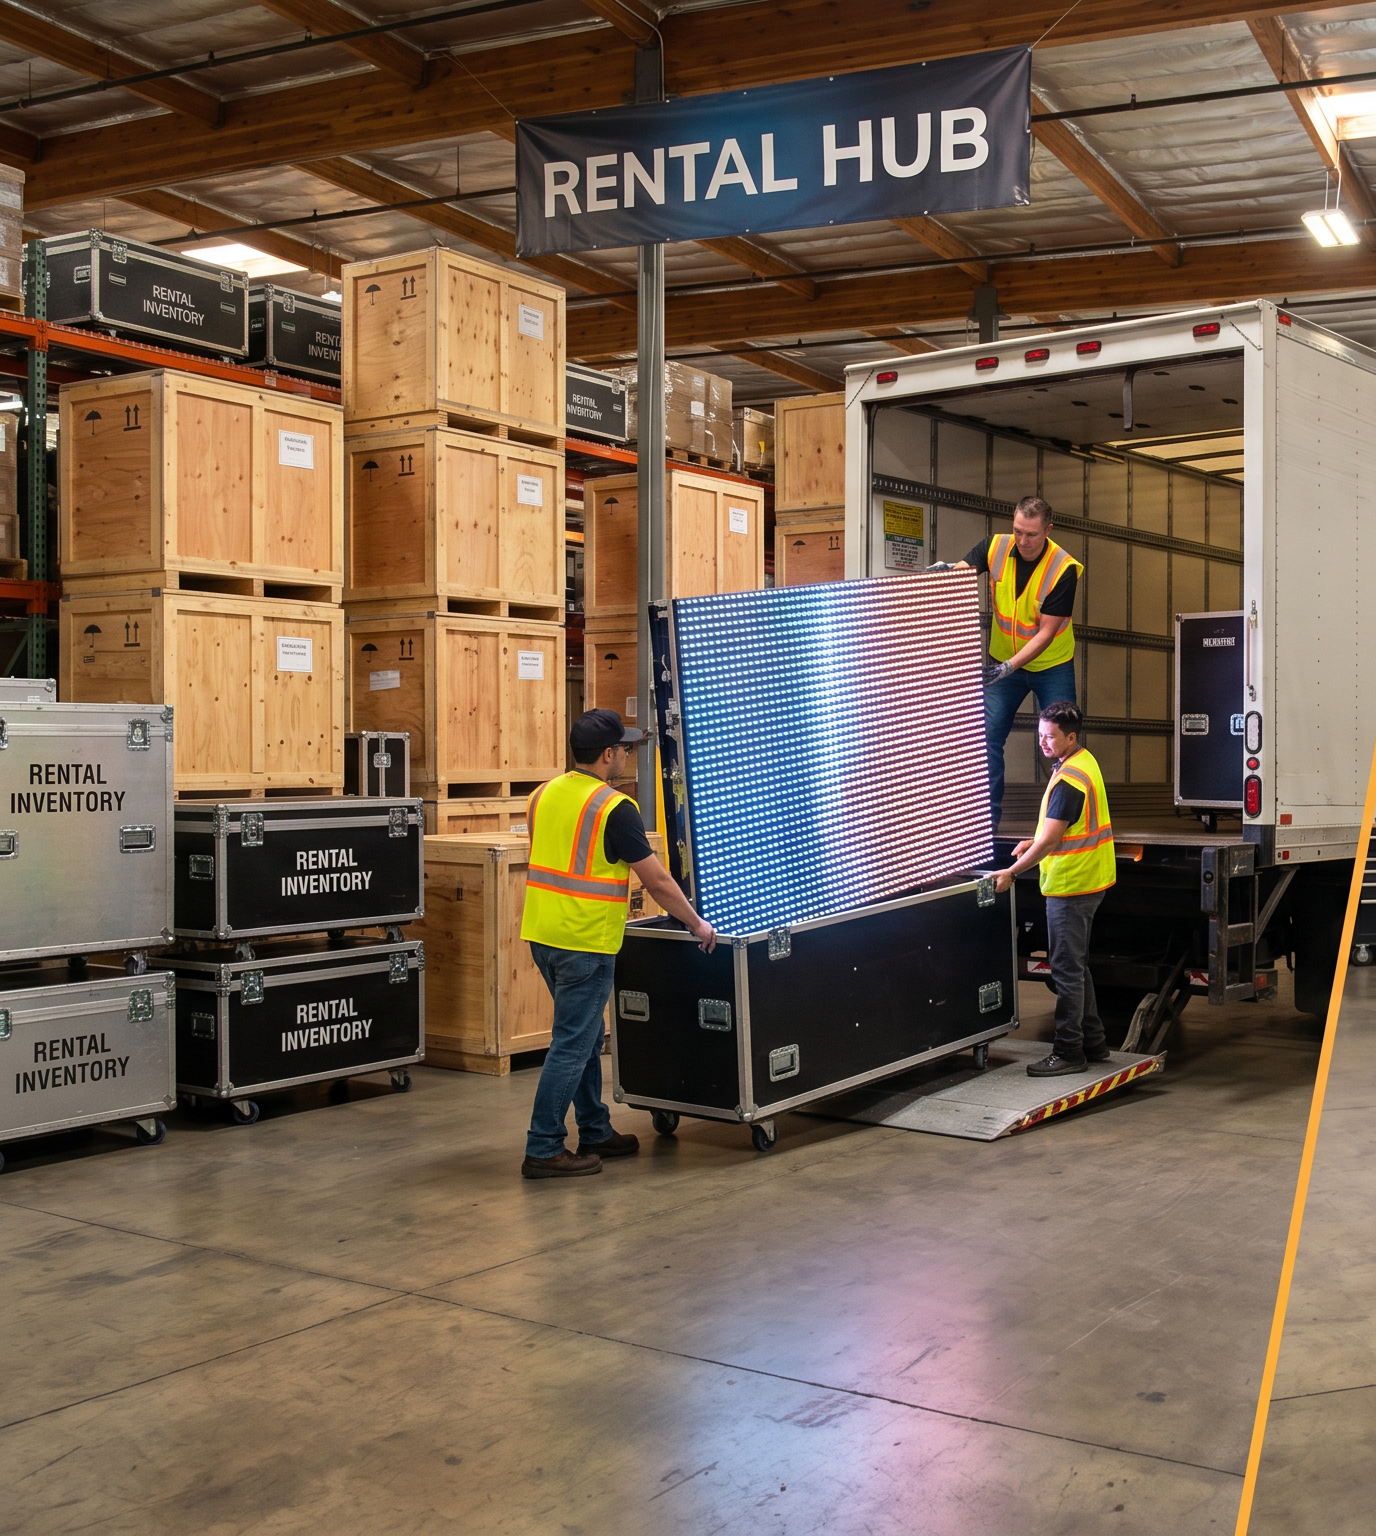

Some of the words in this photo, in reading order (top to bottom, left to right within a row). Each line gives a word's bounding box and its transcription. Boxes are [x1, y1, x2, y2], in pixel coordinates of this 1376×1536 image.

[543, 132, 798, 218] RENTAL
[822, 106, 990, 187] HUB
[152, 284, 196, 308] RENTAL
[143, 299, 205, 327] INVENTORY
[315, 331, 341, 347] RENT
[29, 763, 107, 785] RENTAL
[10, 790, 126, 814] INVENTORY
[296, 848, 358, 871] RENTAL
[281, 870, 373, 897] INVENTORY
[296, 997, 358, 1025] RENTAL
[33, 1032, 112, 1064] RENTAL
[281, 1018, 373, 1052] INVENTORY
[15, 1055, 131, 1095] INVENTORY
